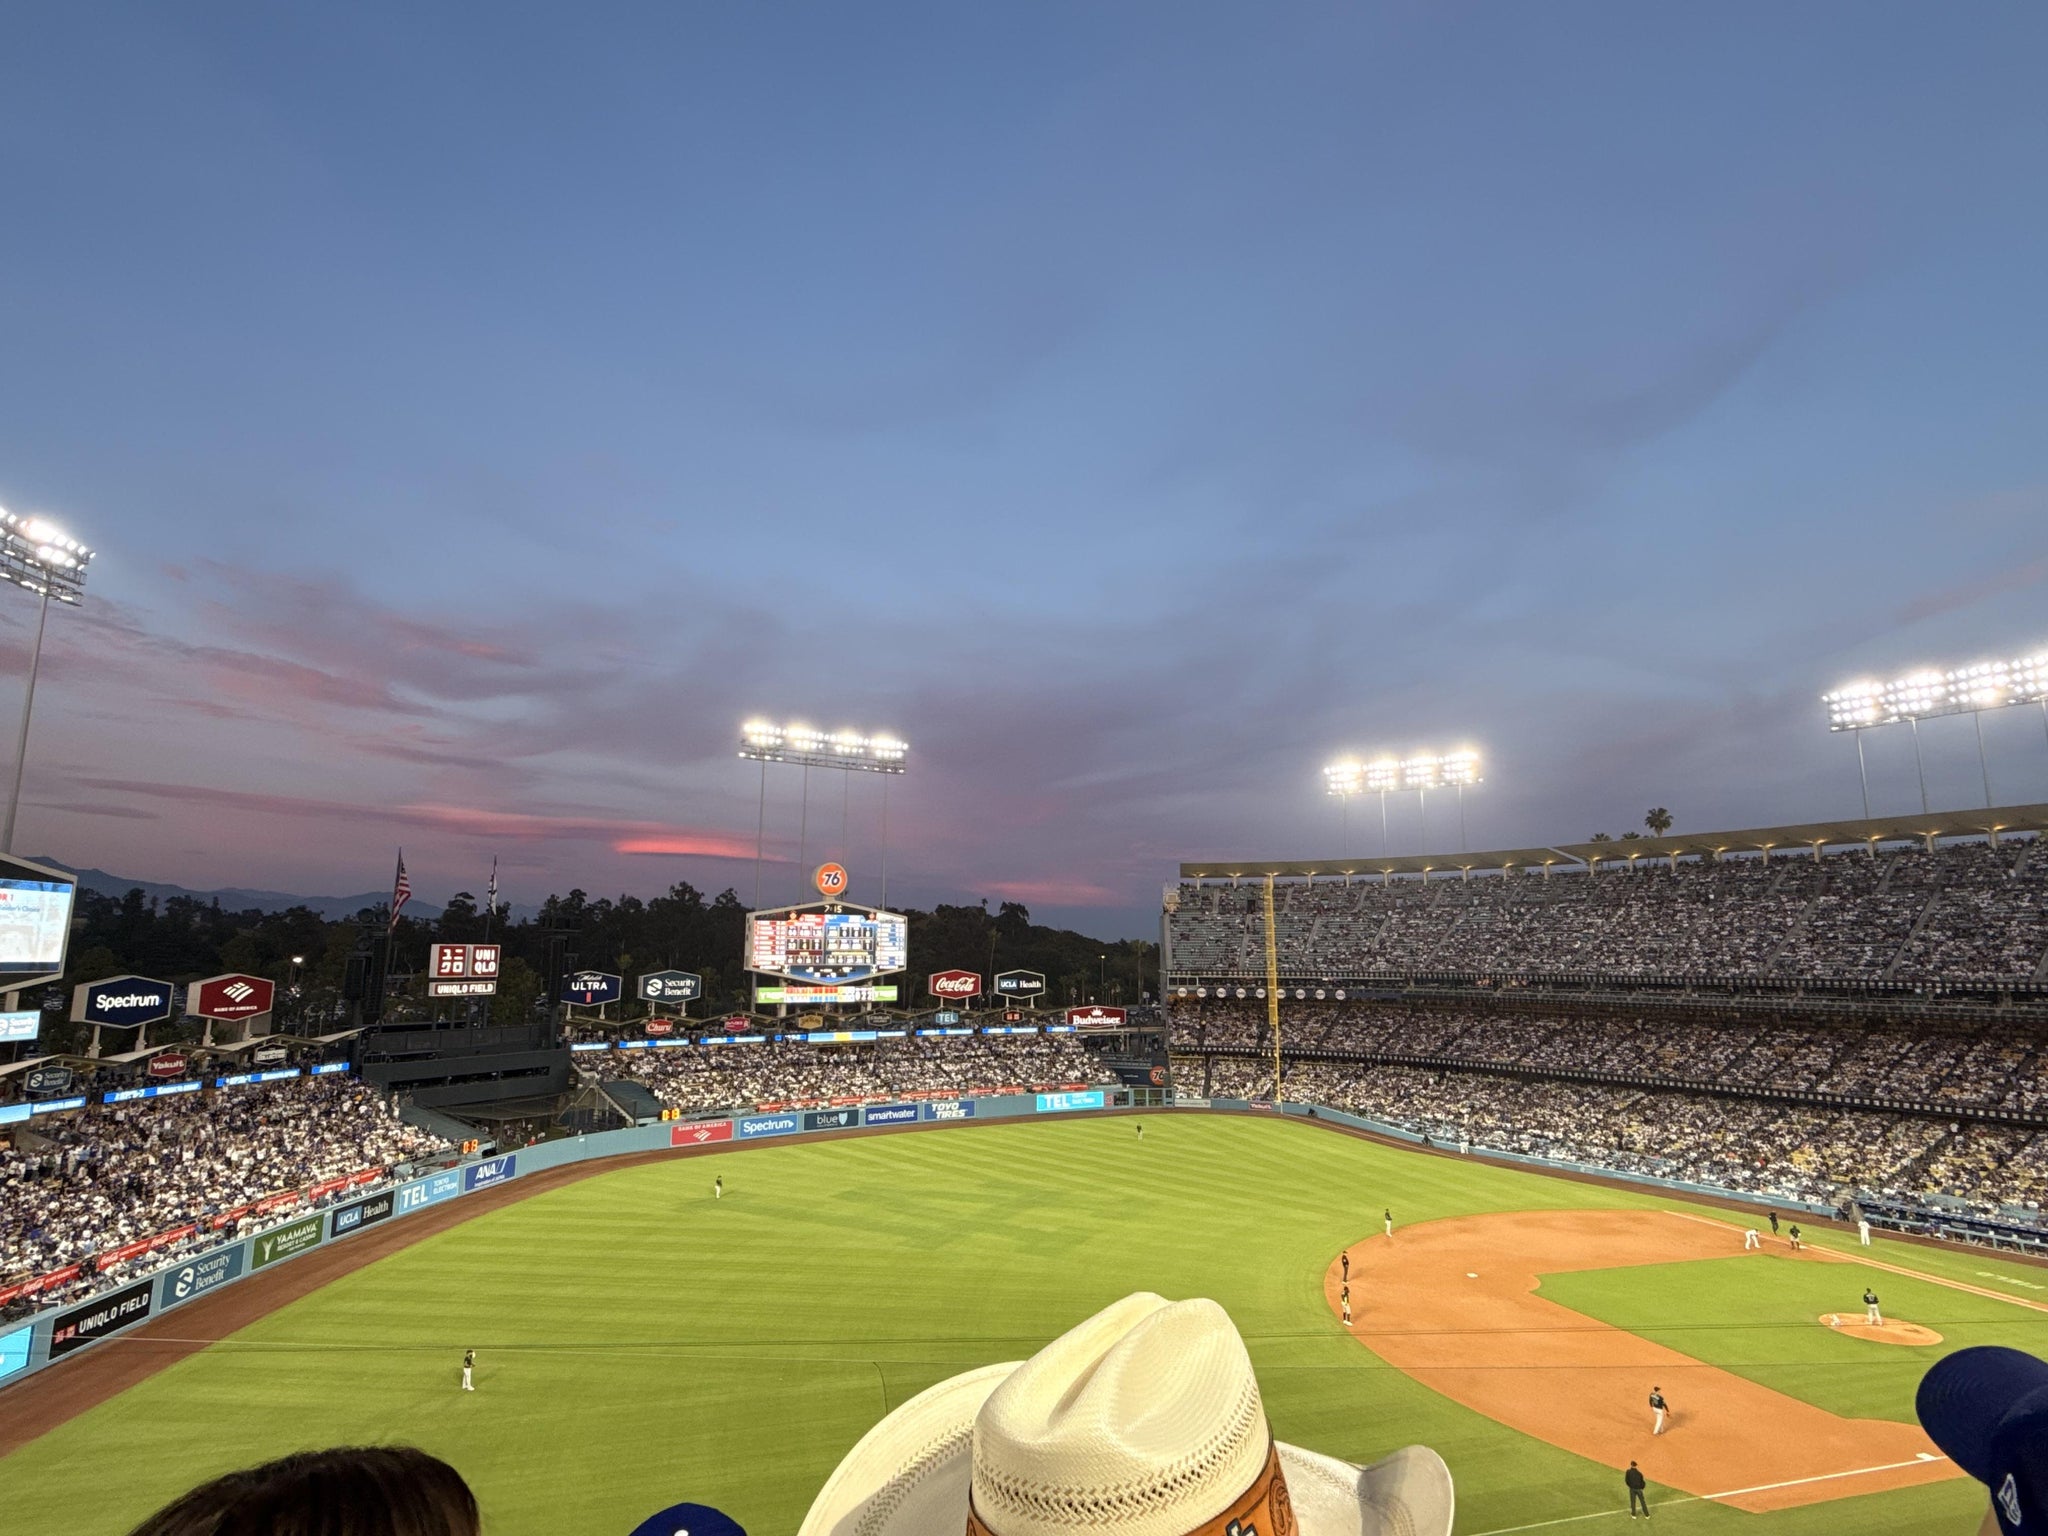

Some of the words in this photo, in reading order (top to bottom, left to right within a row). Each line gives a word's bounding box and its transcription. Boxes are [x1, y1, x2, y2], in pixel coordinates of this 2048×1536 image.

[823, 871, 842, 887] 76
[475, 949, 495, 960] UNI
[474, 961, 496, 974] QLO
[437, 984, 468, 995] UNIQLO
[469, 983, 494, 993] FIELD
[571, 981, 608, 991] ULTRA
[664, 978, 696, 988] Security
[936, 977, 976, 992] Coca-Cola
[1000, 980, 1017, 988] UCLA
[1019, 980, 1042, 988] Health
[664, 987, 691, 996] Benefit
[95, 993, 160, 1012] Spectrum
[939, 1013, 956, 1022] TEL
[1072, 1015, 1121, 1025] Budweiser
[152, 1059, 185, 1071] Yakult
[44, 1070, 69, 1080] Security
[931, 1102, 959, 1112] TOYO
[1044, 1094, 1070, 1109] TEL
[816, 1114, 838, 1125] blue
[867, 1109, 916, 1121] smartwater
[936, 1108, 966, 1119] TIRES
[743, 1119, 790, 1134] Spectrum
[475, 1162, 496, 1180] ANA
[433, 1176, 450, 1187] TOKYO
[402, 1184, 428, 1209] TEL
[339, 1213, 359, 1226] UCLA
[363, 1200, 389, 1219] Health
[196, 1253, 232, 1275] Security
[195, 1268, 225, 1291] Benefit
[78, 1307, 118, 1334] UNIQLO
[119, 1292, 149, 1317] FIELD
